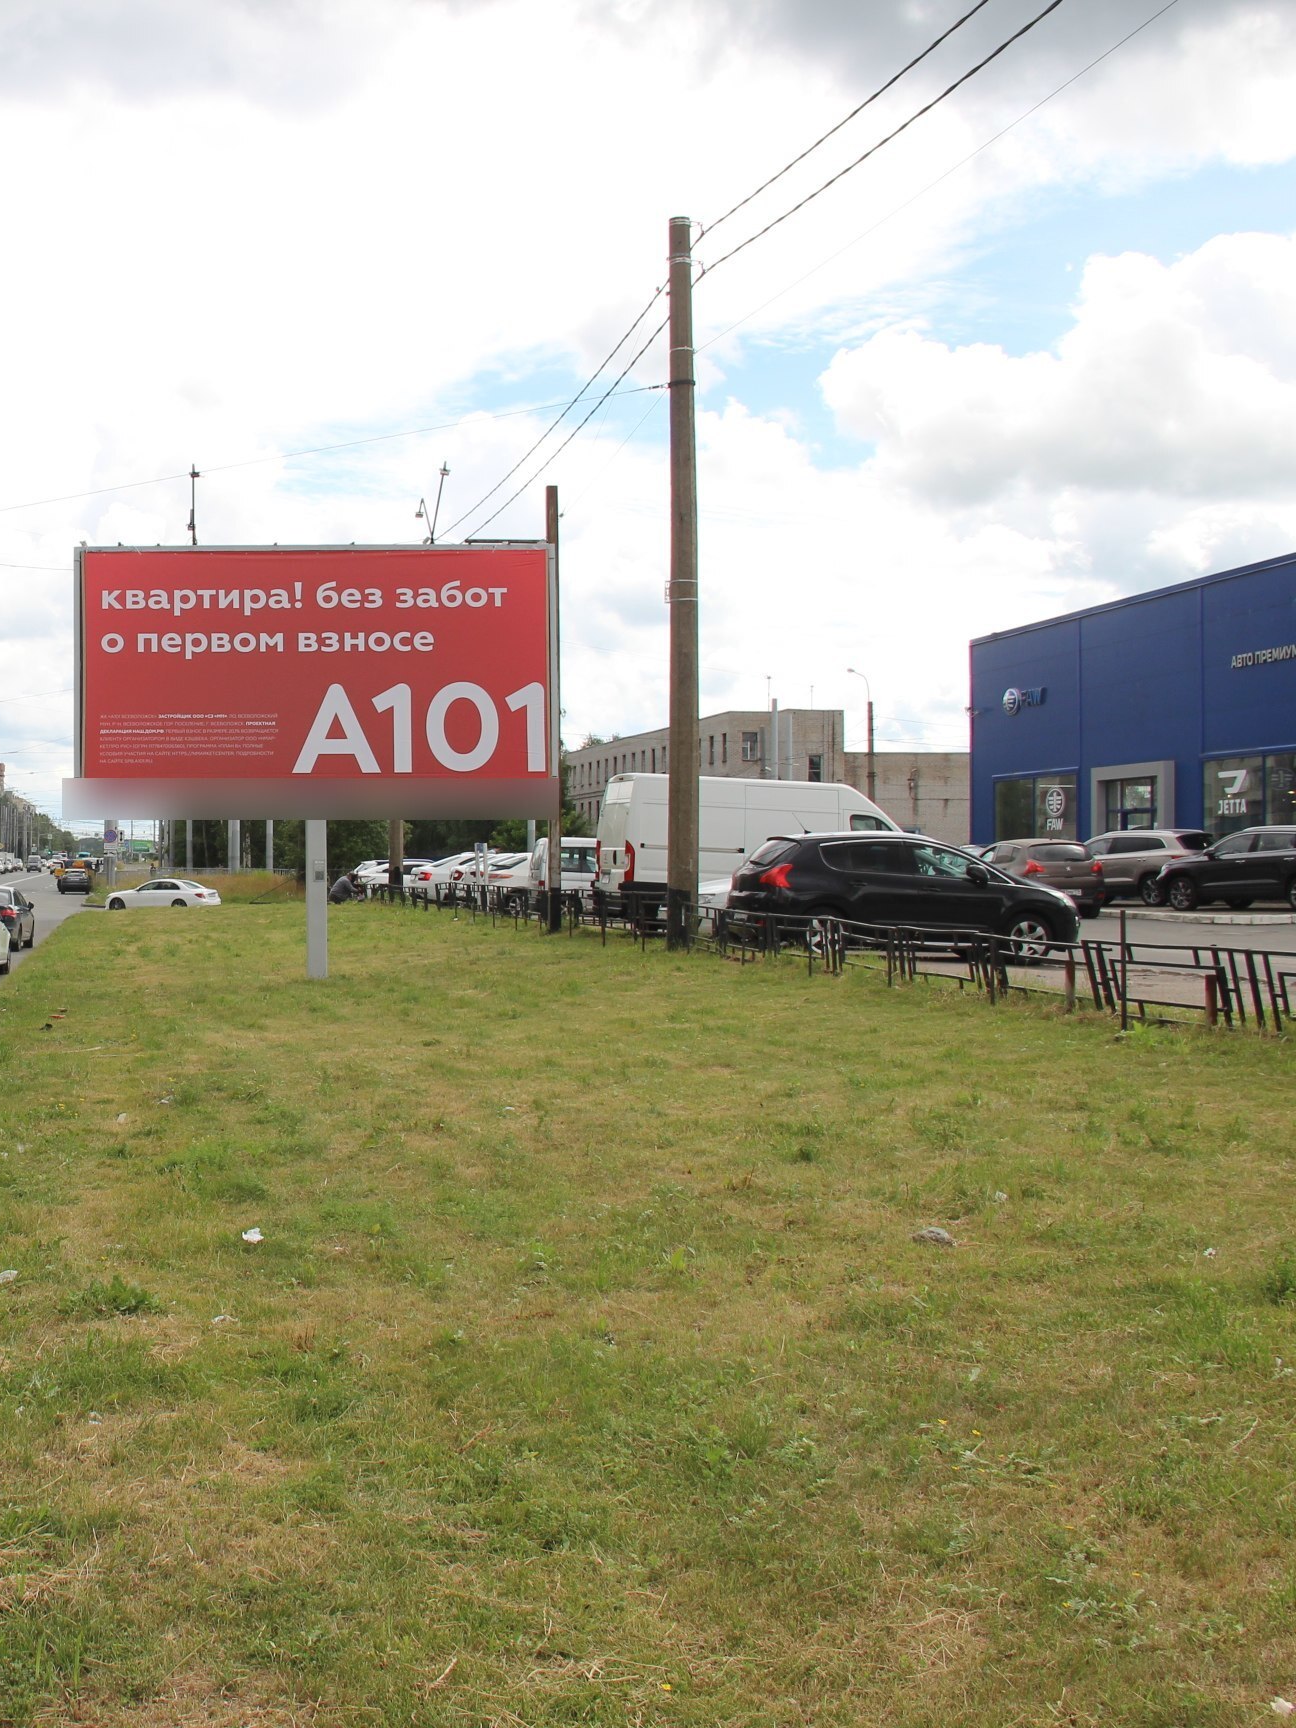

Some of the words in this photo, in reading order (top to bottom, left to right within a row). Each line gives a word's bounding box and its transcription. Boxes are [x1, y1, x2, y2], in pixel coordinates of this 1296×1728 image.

[101, 581, 303, 616] квартира!
[316, 581, 383, 609] без
[395, 579, 508, 608] забот
[100, 632, 125, 654] о
[137, 632, 284, 660] первом
[297, 631, 435, 653] взносе
[1231, 652, 1253, 668] АВТО
[1218, 799, 1247, 815] JETTA
[1046, 818, 1064, 831] FAW
